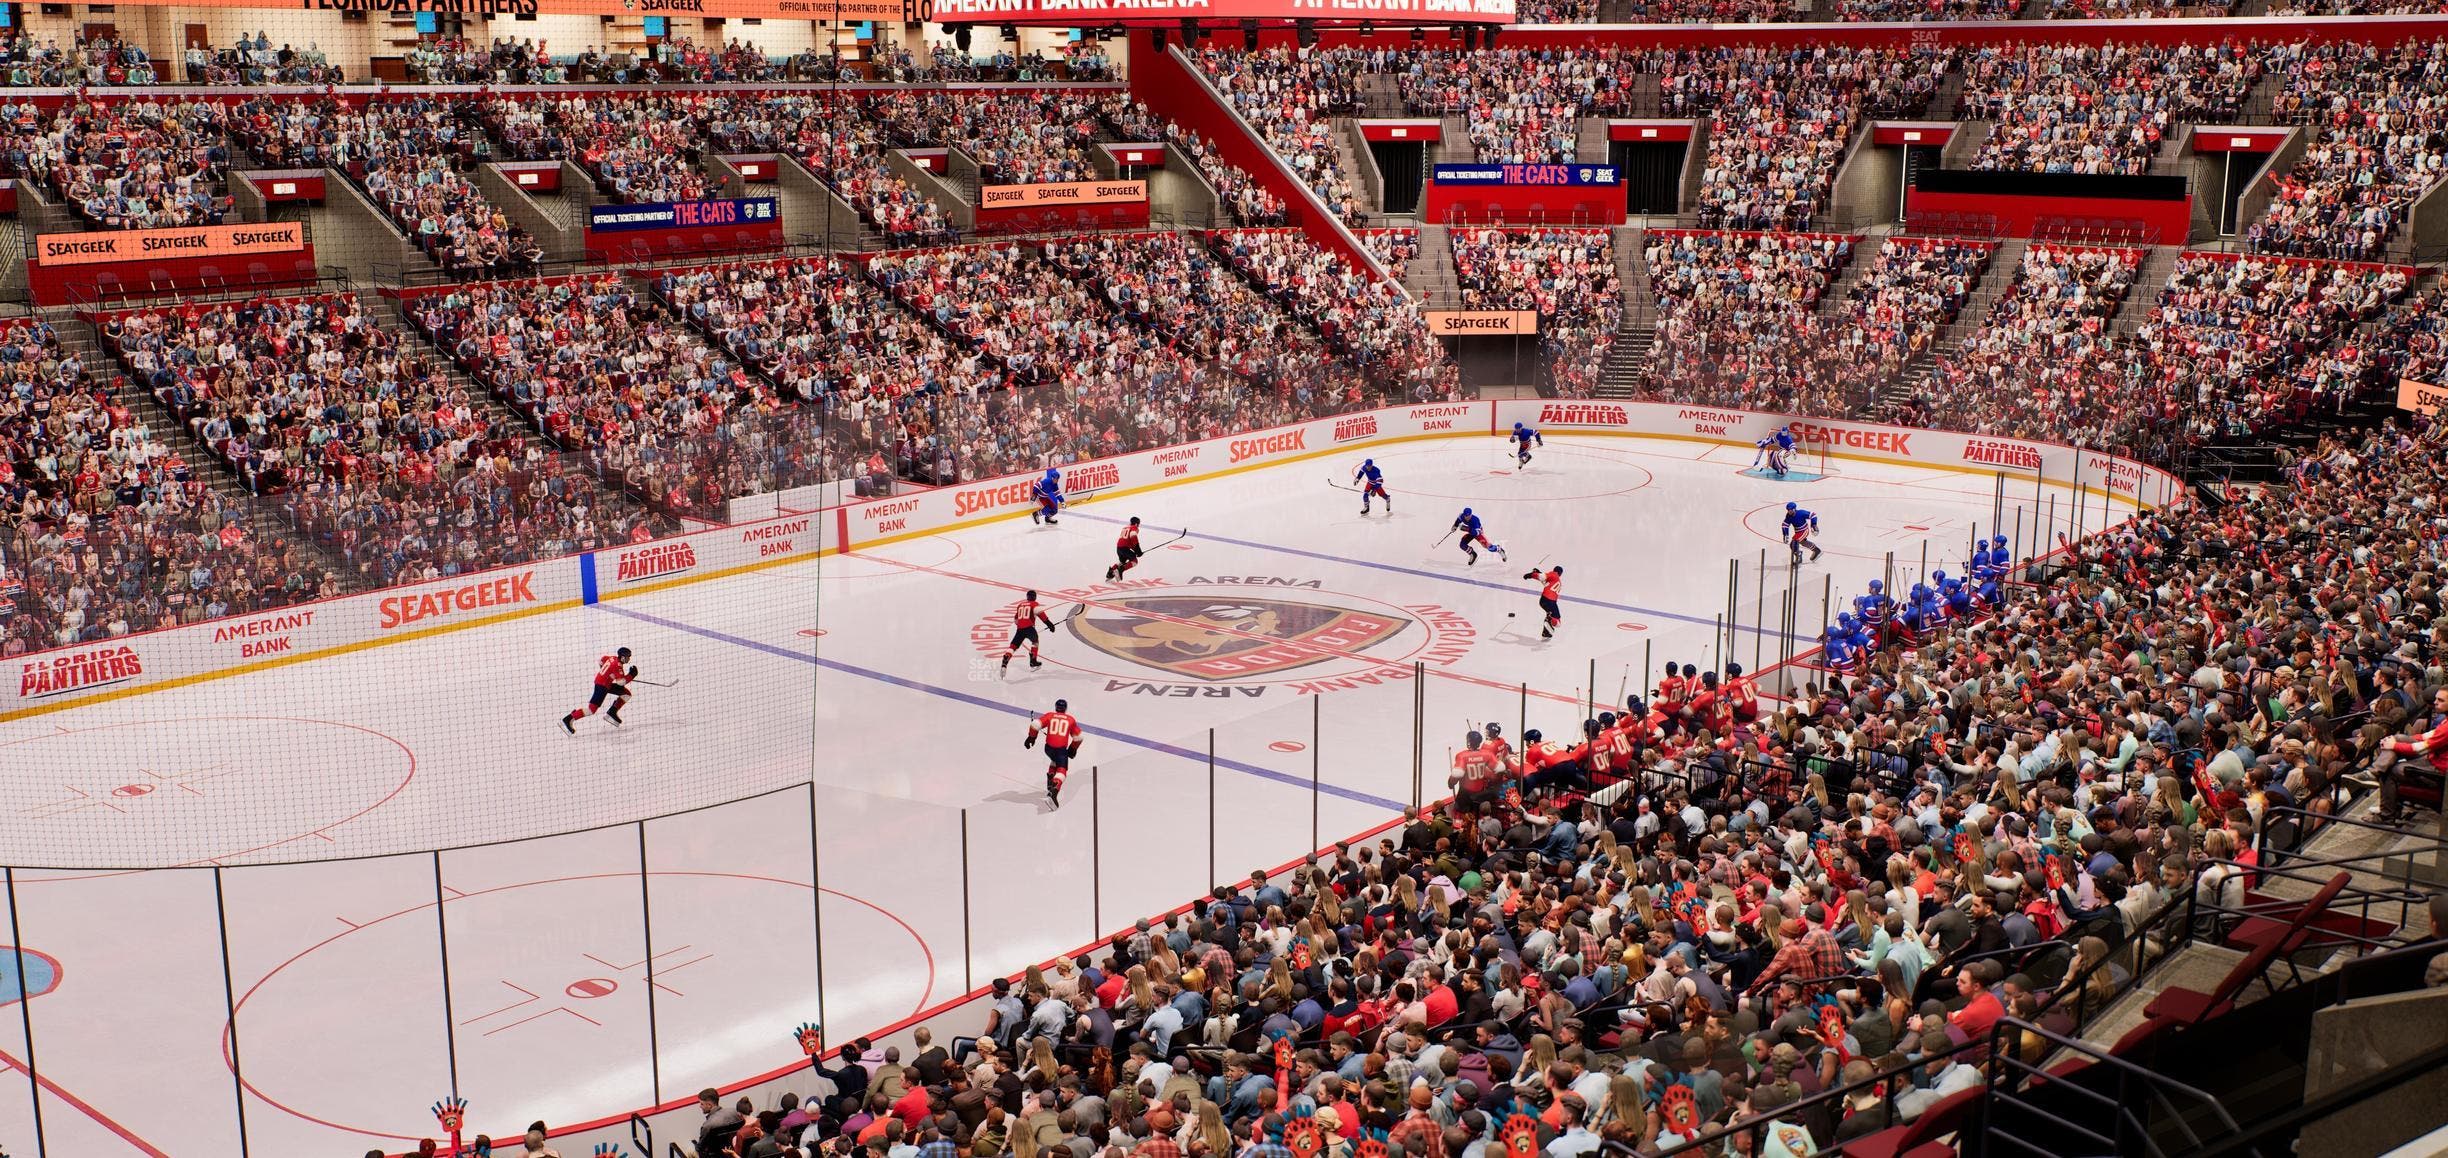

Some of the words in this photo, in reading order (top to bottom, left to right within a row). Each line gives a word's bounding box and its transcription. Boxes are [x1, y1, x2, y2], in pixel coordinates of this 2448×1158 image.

[641, 0, 704, 12] SEATGEEK
[779, 2, 810, 12] OFFICIAL
[812, 3, 847, 12] TICKETNG
[849, 4, 877, 13] PARTNER
[879, 5, 887, 13] OF
[889, 5, 900, 14] THE
[1503, 165, 1523, 184] THE
[1525, 165, 1568, 184] CATS
[987, 190, 1024, 202] SEATGEEK
[1038, 188, 1079, 199] SEATGEEK
[1096, 186, 1140, 197] SEATGEEK
[667, 211, 674, 220] OF
[673, 203, 699, 225] THE
[701, 201, 736, 223] CATS
[142, 234, 208, 251] SEATGEEK
[233, 229, 294, 246] SEATGEEK
[47, 239, 116, 256] SEATGEEK
[1445, 317, 1510, 330] SEATGEEK
[1336, 415, 1375, 427] FLORIDA
[1410, 406, 1469, 420] AMERANT
[1539, 410, 1628, 424] PANTHERS
[1678, 409, 1744, 425] AMERANT
[1334, 422, 1378, 441] PANTHERS
[1424, 420, 1453, 431] BANK
[1695, 423, 1727, 436] BANK
[1230, 428, 1306, 463] SEATGEEK
[1789, 421, 1911, 456] SEATGEEK
[1968, 439, 2038, 454] FLORIDA
[1152, 447, 1200, 465] AMERANT
[1962, 446, 2041, 468] PANTHERS
[1067, 463, 1116, 477] FLORIDA
[1164, 463, 1188, 477] BANK
[2089, 458, 2151, 483] AMERANT
[1065, 470, 1120, 493] PANTHERS
[2104, 476, 2135, 494] BANK
[955, 476, 1043, 517] SEATGEE
[864, 499, 919, 519] AMERANT
[743, 519, 809, 543] AMERANT
[879, 517, 907, 534] BANK
[621, 542, 690, 561] FLORIDA
[760, 539, 793, 557] BANK
[617, 549, 696, 580] PANTHERS
[1058, 577, 1174, 598] BANK
[1186, 575, 1322, 589] ARENA
[380, 571, 535, 628] SEATGEEK
[1016, 605, 1031, 620] 00
[213, 610, 315, 643] AMERANT
[1403, 604, 1477, 666] AMERANT
[242, 636, 292, 659] BANK
[1201, 618, 1381, 671] FLOIDA
[24, 646, 133, 673] FLORIDA
[20, 654, 142, 697] PANTHERS
[1284, 668, 1417, 695] BANK
[1103, 679, 1267, 698] ARENA
[1049, 718, 1069, 736] 00
[1466, 762, 1486, 780] 00
